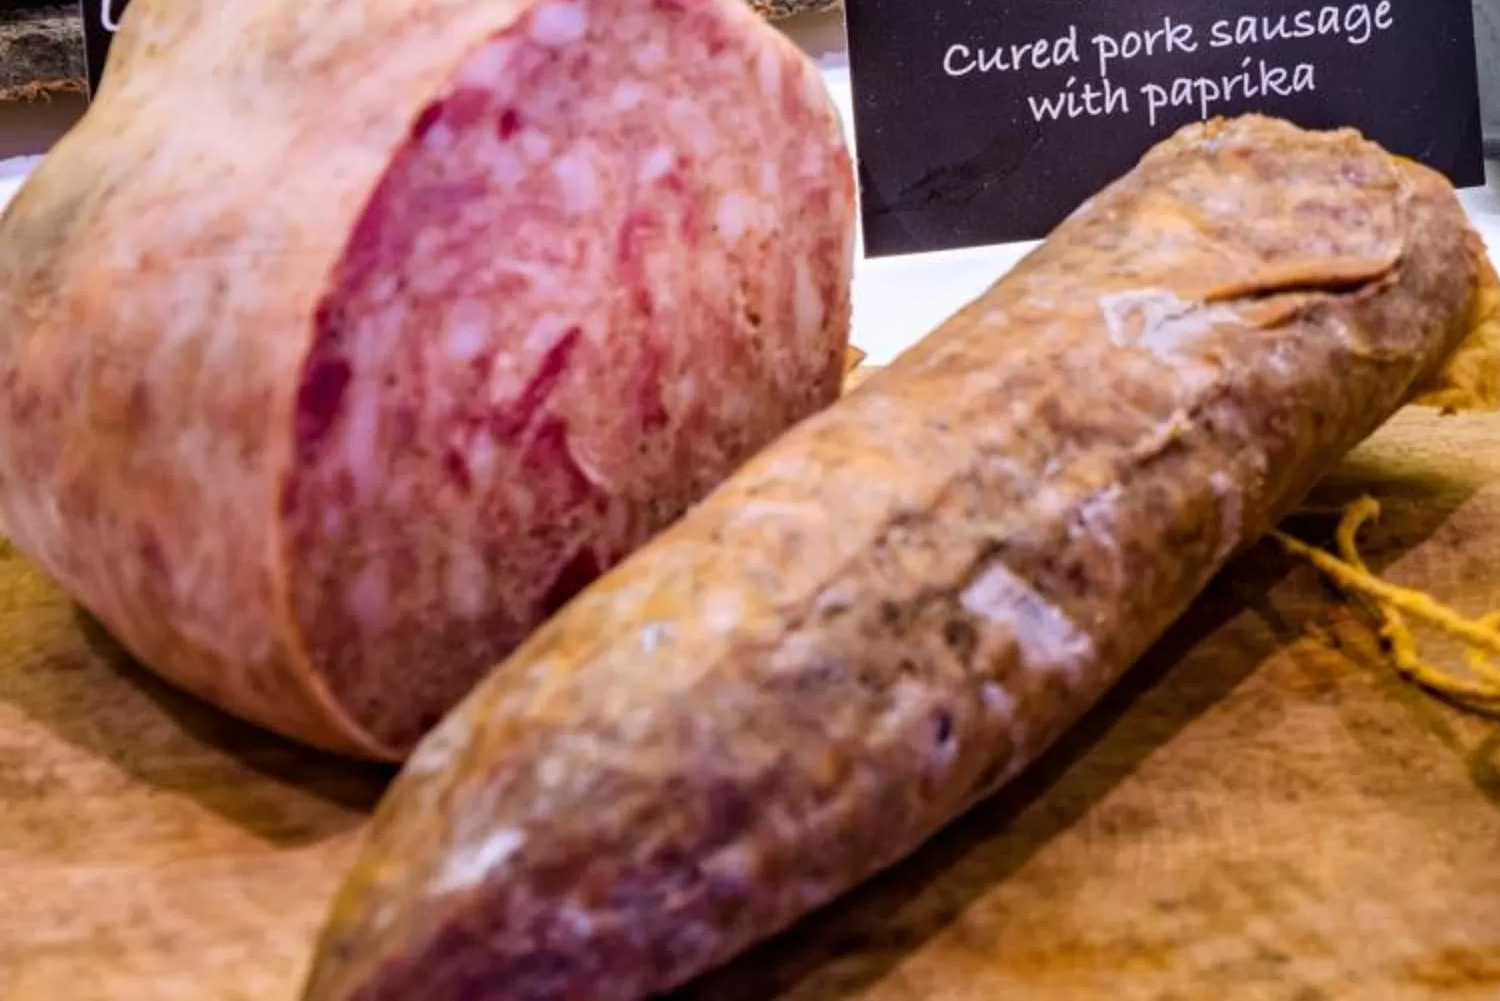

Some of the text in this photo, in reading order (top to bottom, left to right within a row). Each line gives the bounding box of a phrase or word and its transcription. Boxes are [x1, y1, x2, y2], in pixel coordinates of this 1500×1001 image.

[942, 26, 1080, 77] Cured
[1091, 16, 1199, 77] pork
[1026, 55, 1317, 127] with paprika
